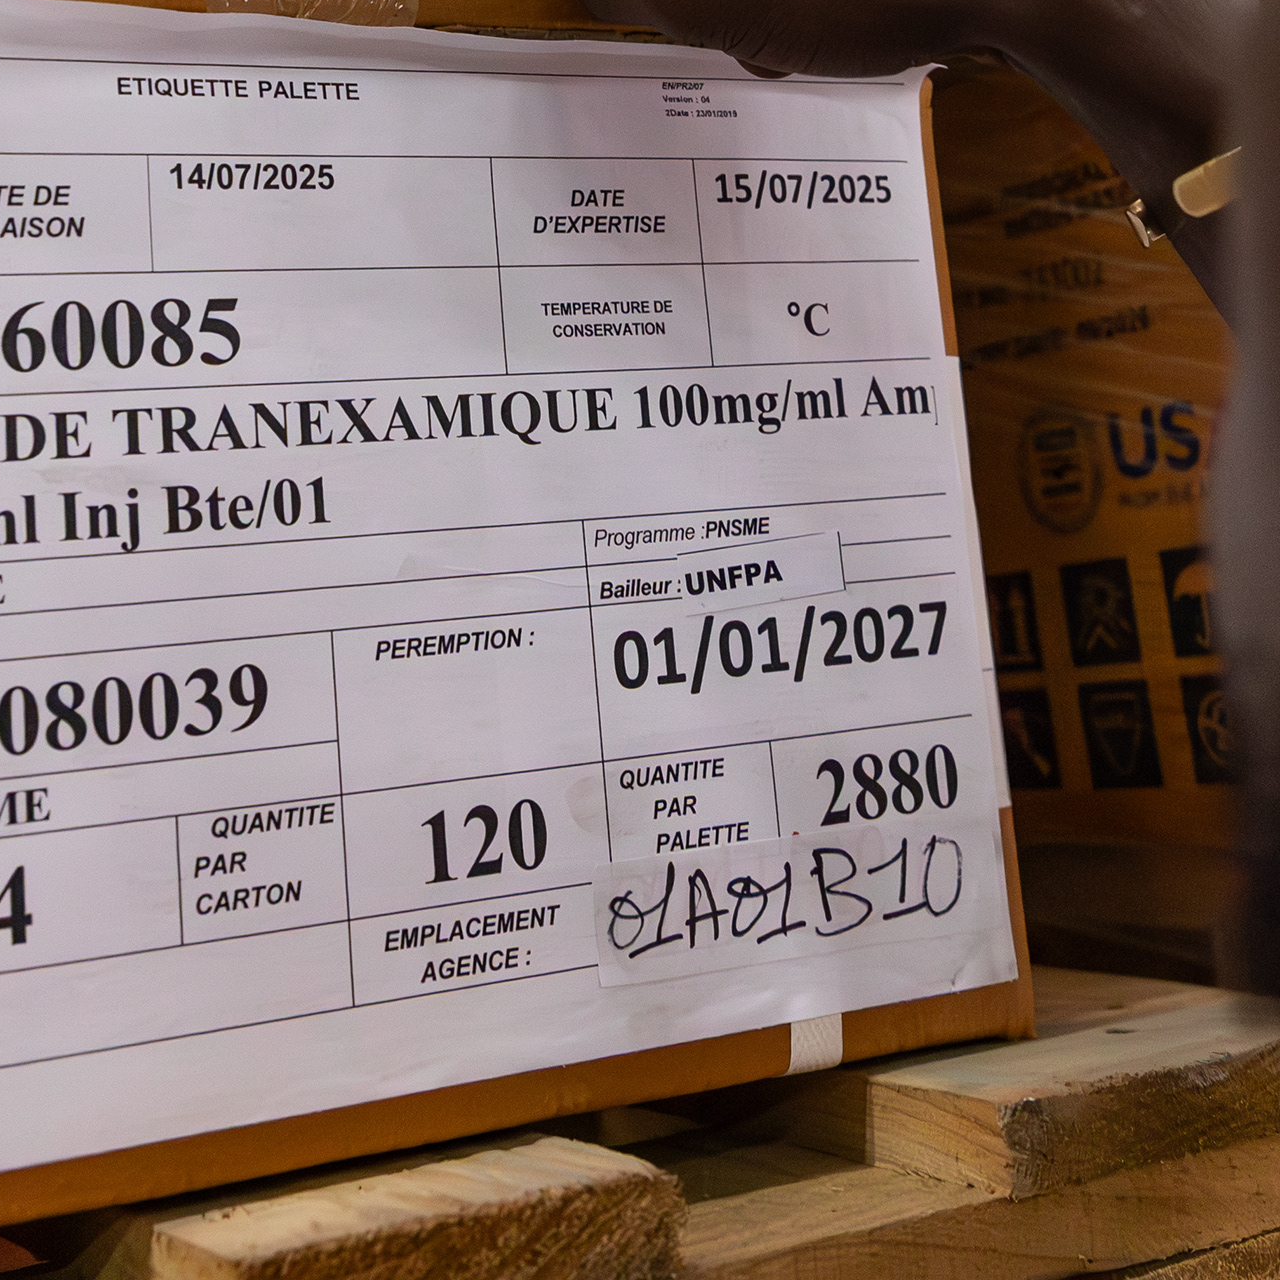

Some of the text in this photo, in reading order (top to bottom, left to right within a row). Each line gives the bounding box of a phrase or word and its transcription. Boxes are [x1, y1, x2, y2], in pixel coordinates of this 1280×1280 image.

[117, 76, 361, 101] ETIQUETTE PALETTE
[170, 163, 335, 191] 14/07/2025
[714, 172, 892, 210] 15/07/2025
[32, 185, 72, 207] DE
[570, 189, 626, 208] DATE
[532, 214, 667, 235] D'EXPERTISE
[540, 300, 674, 317] TEMPERATURE DE
[786, 301, 832, 338] °C
[552, 321, 667, 339] CONSERVATION
[111, 387, 619, 456] TRANEXAMIQUE
[633, 376, 847, 434] 100mg/ml
[860, 376, 939, 425] Am
[58, 486, 142, 553] Inj
[162, 474, 333, 536] Bte/01
[593, 524, 696, 554] Programme
[599, 559, 784, 600] Bailleur UNFPA
[375, 629, 523, 662] PEREMPTION
[613, 600, 949, 695] 01/01/2027
[618, 758, 726, 791] QUANTITE
[816, 744, 959, 827] 2880
[211, 803, 337, 838] QUANTITE
[653, 795, 699, 820] PAR
[421, 798, 549, 886] 120
[655, 822, 750, 855] PALETTE
[193, 851, 248, 879] PAR
[195, 880, 303, 916] CARTON
[384, 904, 561, 953] EMPLACEMENT
[420, 948, 522, 986] AGENCE
